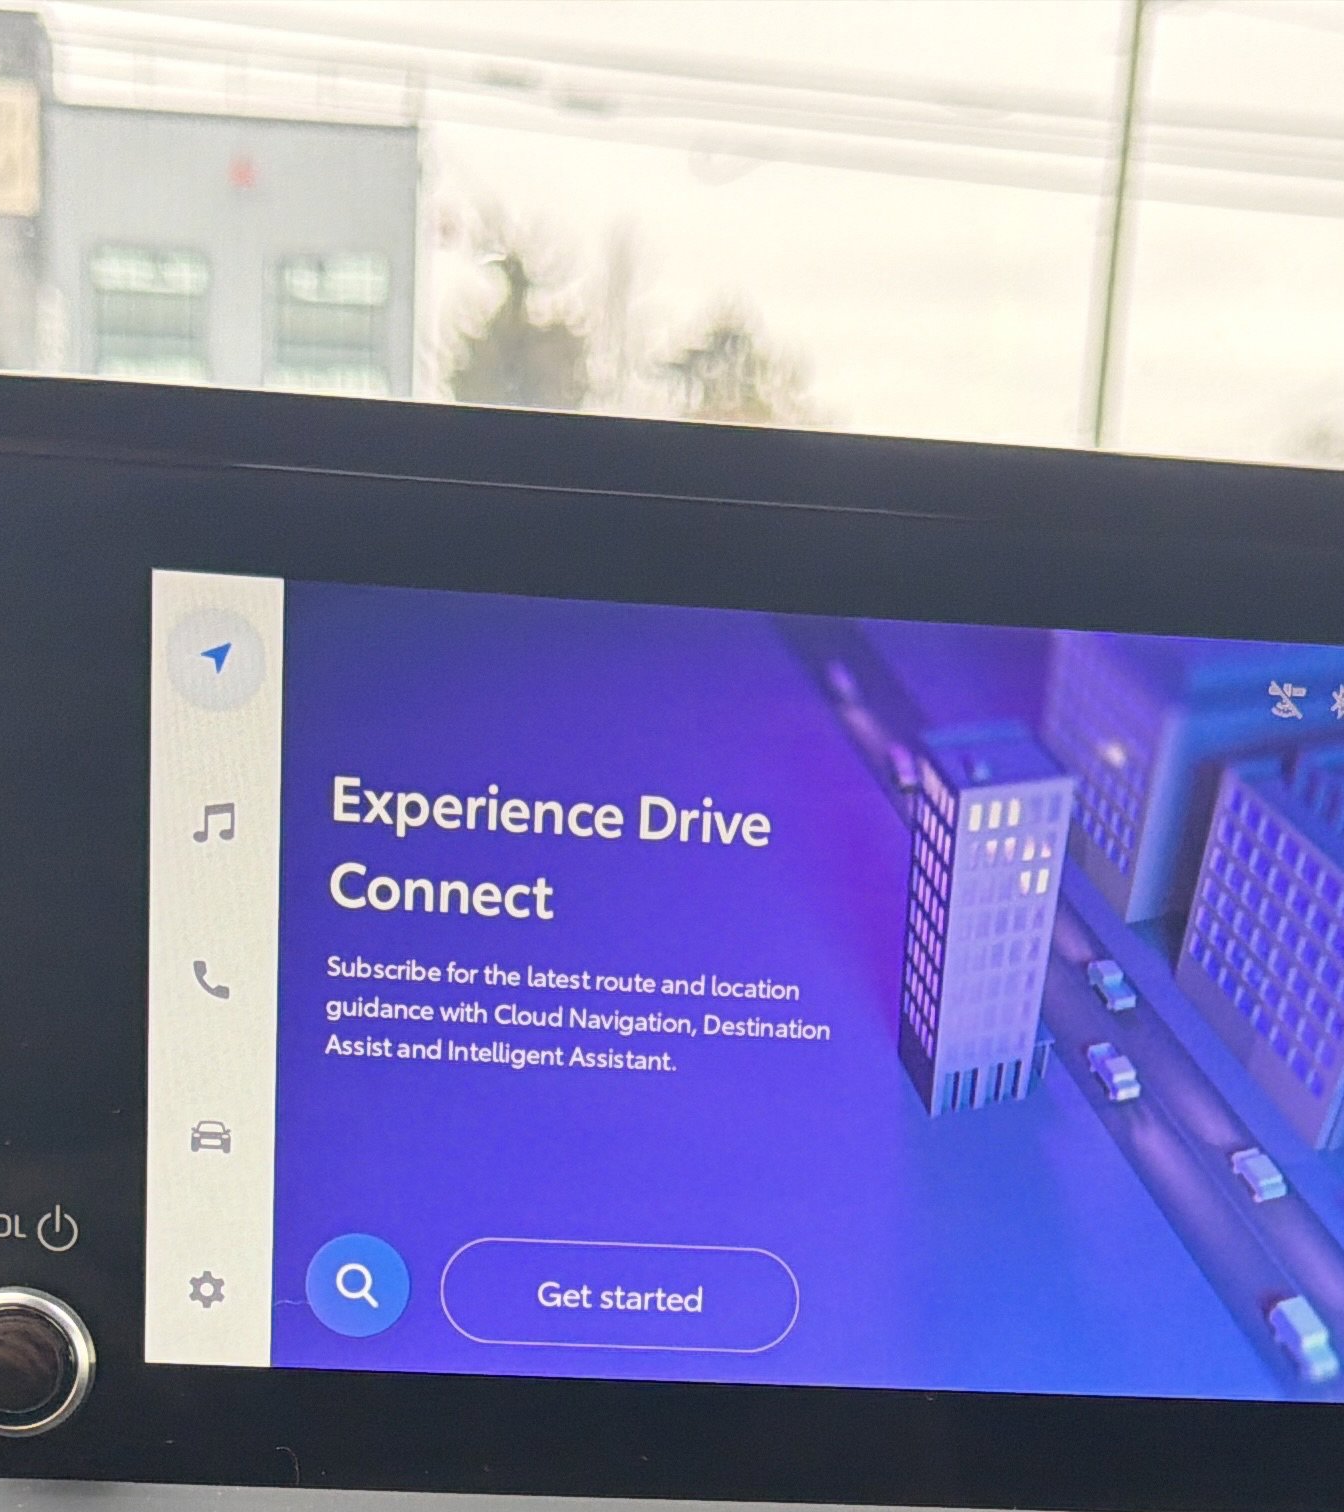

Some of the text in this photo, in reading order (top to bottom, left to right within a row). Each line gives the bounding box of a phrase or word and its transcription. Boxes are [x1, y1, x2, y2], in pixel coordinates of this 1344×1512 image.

[332, 775, 772, 847] Experience Drive
[329, 862, 555, 920] Connect
[327, 955, 800, 1001] Subscribe for the latest route and location
[325, 996, 831, 1041] guidance with Cloud Navigation, Destination
[325, 1033, 677, 1072] Assist and Intelligent Assistant.
[535, 1280, 704, 1314] Get started
